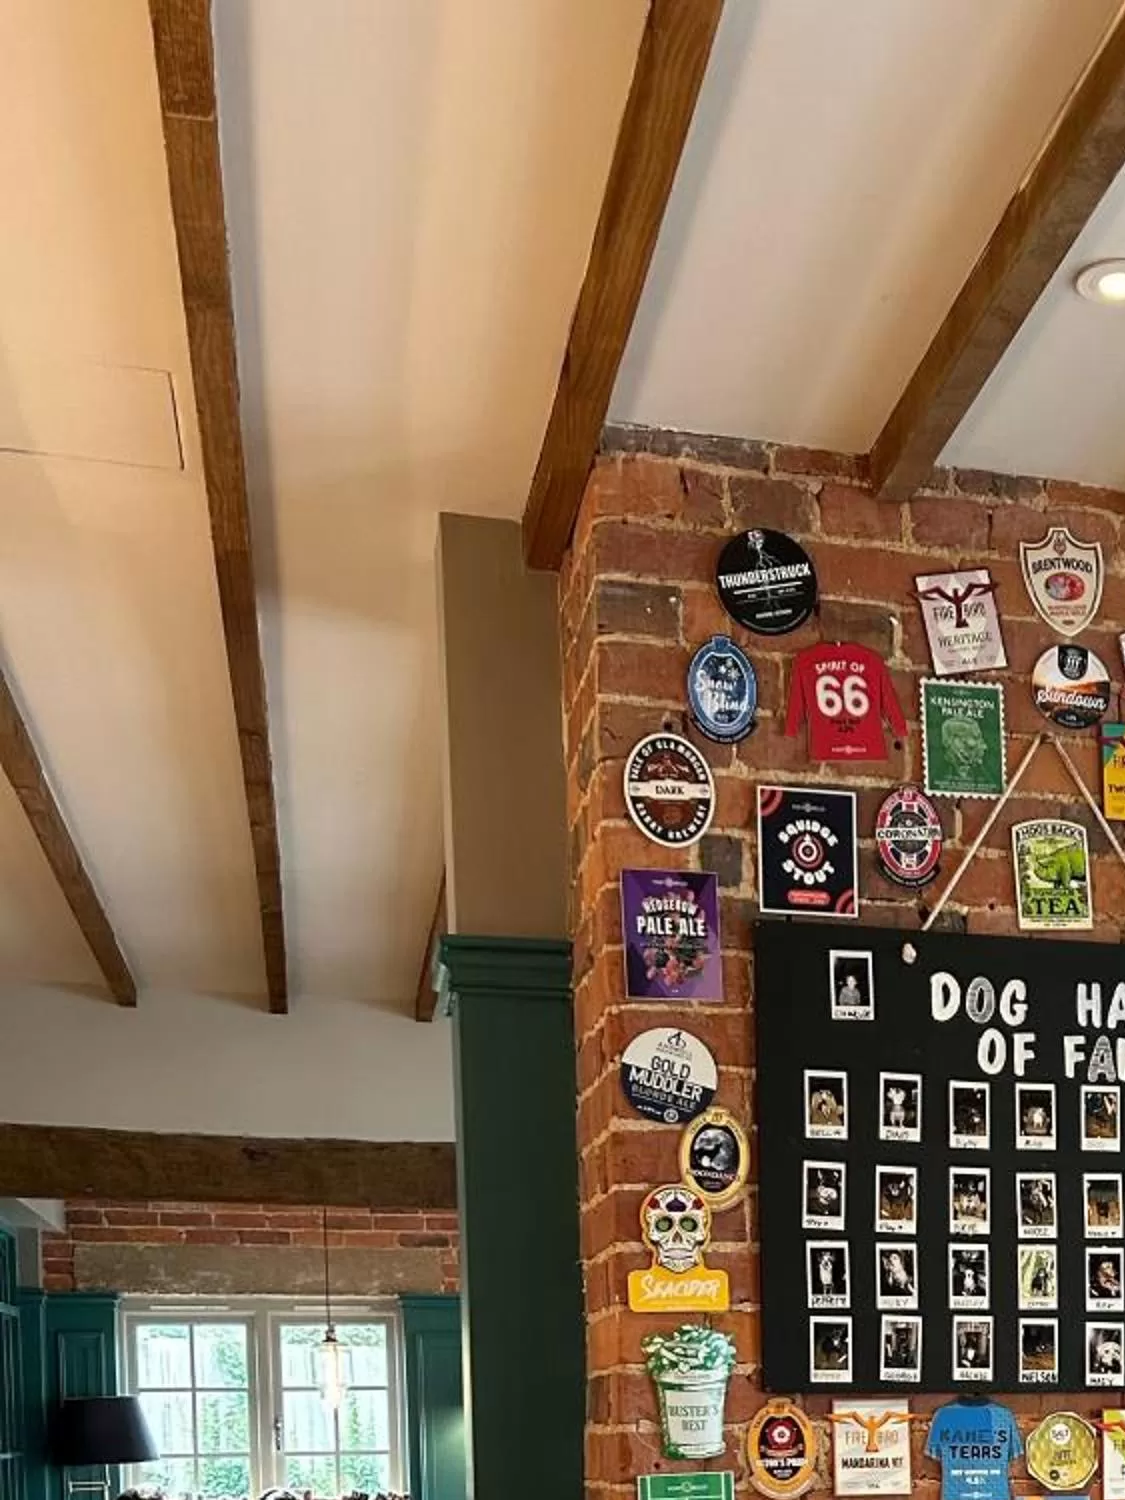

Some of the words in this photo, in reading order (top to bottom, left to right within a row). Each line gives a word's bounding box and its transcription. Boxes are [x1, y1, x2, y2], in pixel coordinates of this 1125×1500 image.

[1031, 557, 1093, 574] BRENTWOOD
[718, 563, 811, 589] THUNDERSTRUCK
[938, 632, 992, 648] HERITAGE
[816, 661, 846, 674] SPIRIT
[849, 662, 865, 673] OF
[816, 675, 869, 717] 66
[930, 696, 995, 710] KENSINGTON
[1037, 686, 1106, 709] Sundown
[941, 706, 963, 718] PALE
[966, 708, 984, 719] ALE
[641, 744, 652, 757] OF
[656, 785, 684, 795] DARK
[668, 804, 706, 840] BREWERY
[777, 819, 839, 847] SQUIDGE
[782, 860, 835, 885] STOUT
[642, 899, 698, 916] HEDGEROW
[1029, 897, 1080, 914] TEA
[636, 915, 674, 936] PALE
[677, 918, 707, 937] ALE
[930, 972, 1028, 1026] DOG
[977, 1028, 1036, 1077] OF
[651, 1056, 690, 1081] GOLD
[629, 1066, 703, 1101] MUDDLER
[669, 1405, 719, 1418] BUSTER'S
[682, 1419, 707, 1431] BEST
[844, 1431, 866, 1445] FIRE
[939, 1429, 1008, 1443] KANE'S
